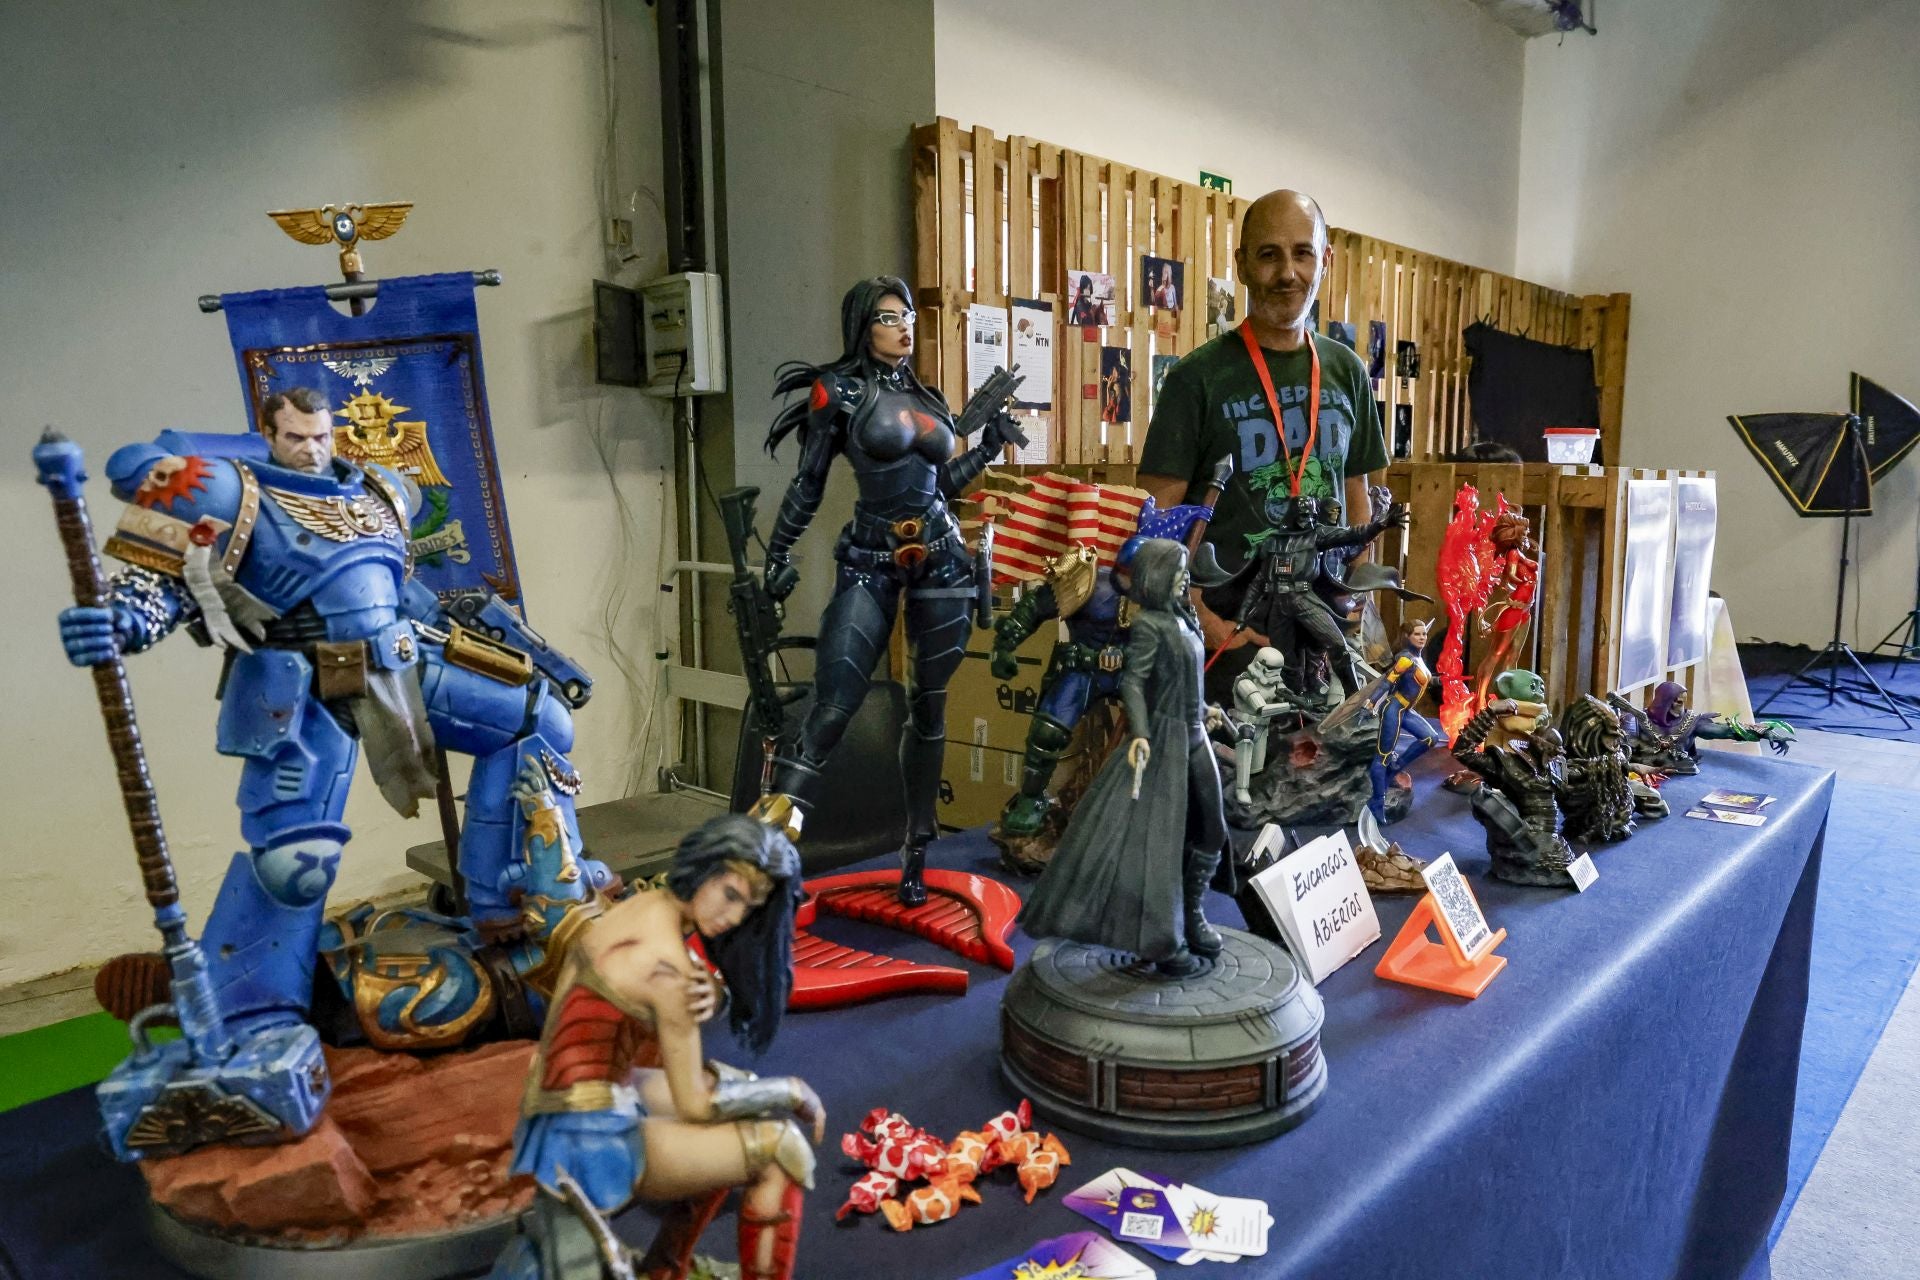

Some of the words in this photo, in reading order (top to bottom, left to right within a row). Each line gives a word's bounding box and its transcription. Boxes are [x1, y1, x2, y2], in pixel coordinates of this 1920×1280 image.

[1035, 336, 1050, 347] NTN
[1222, 385, 1352, 419] INCEDBLE
[1237, 406, 1352, 472] DAD
[1292, 847, 1348, 902] ENCARGOS
